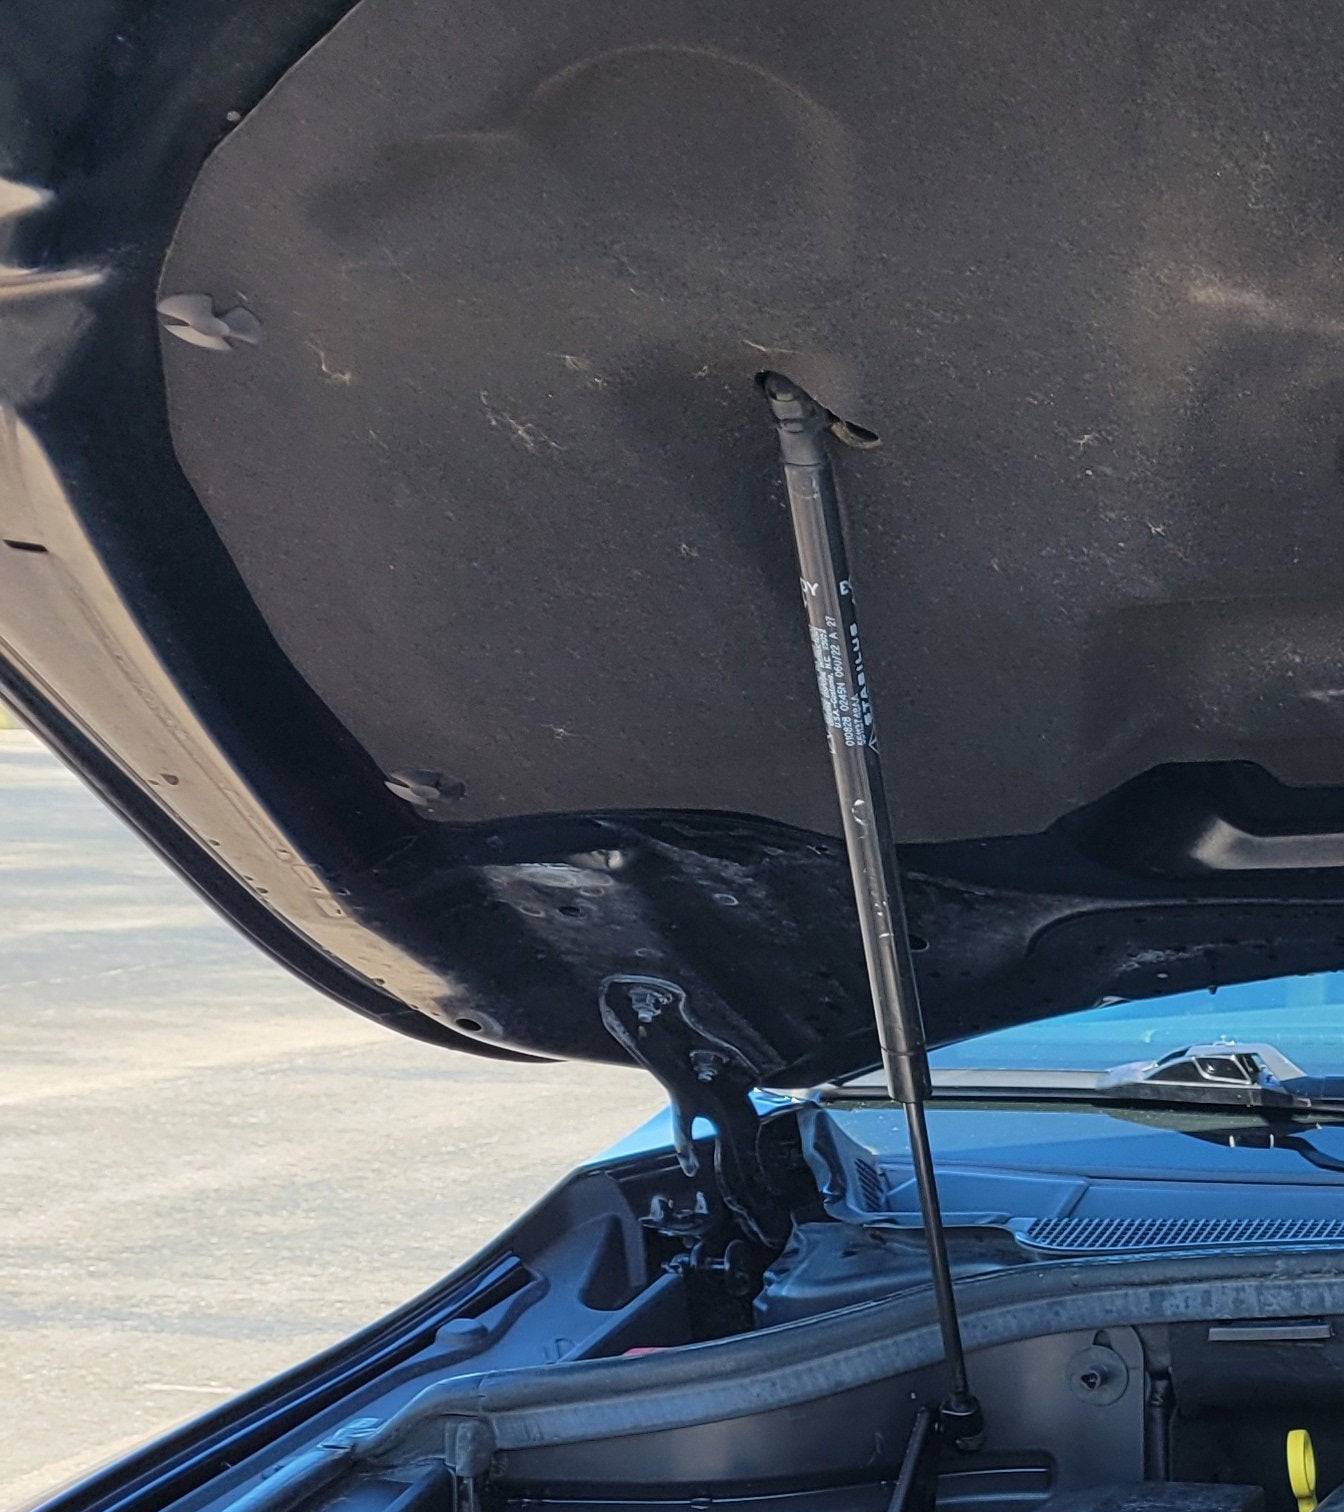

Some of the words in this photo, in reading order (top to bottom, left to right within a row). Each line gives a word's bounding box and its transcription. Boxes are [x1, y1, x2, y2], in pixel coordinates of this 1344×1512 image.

[825, 615, 836, 627] 27
[849, 623, 873, 726] STABILUS
[836, 682, 849, 712] 0245N
